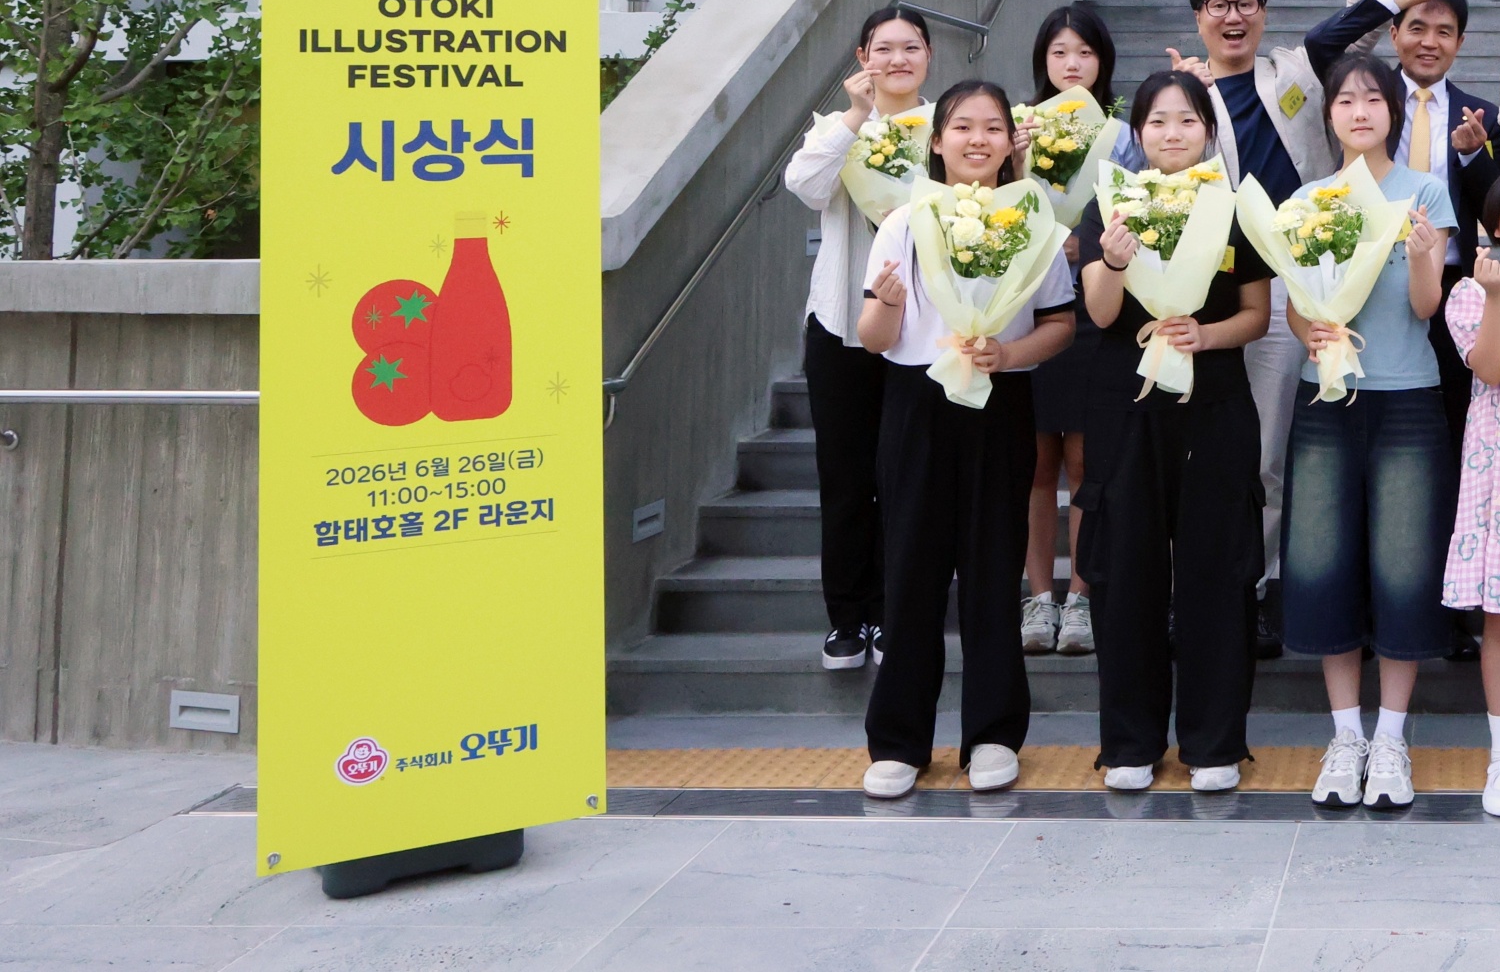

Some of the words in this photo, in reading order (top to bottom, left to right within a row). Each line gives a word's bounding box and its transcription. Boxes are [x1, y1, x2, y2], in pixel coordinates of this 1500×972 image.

[299, 29, 567, 53] ILLUSTRATION
[347, 64, 524, 88] FESTIVAL
[331, 118, 534, 182] 시상식
[326, 460, 408, 486] 2026년
[415, 457, 450, 478] 6월
[458, 447, 544, 473] 26일(금)
[367, 477, 506, 507] 11:00~15:00
[313, 511, 424, 547] 함태호홀
[434, 508, 469, 532] 2F
[478, 497, 555, 527] 라운지
[395, 750, 453, 773] 주식회사
[460, 723, 538, 762] 오뚜기
[347, 760, 378, 775] 오뚜기
